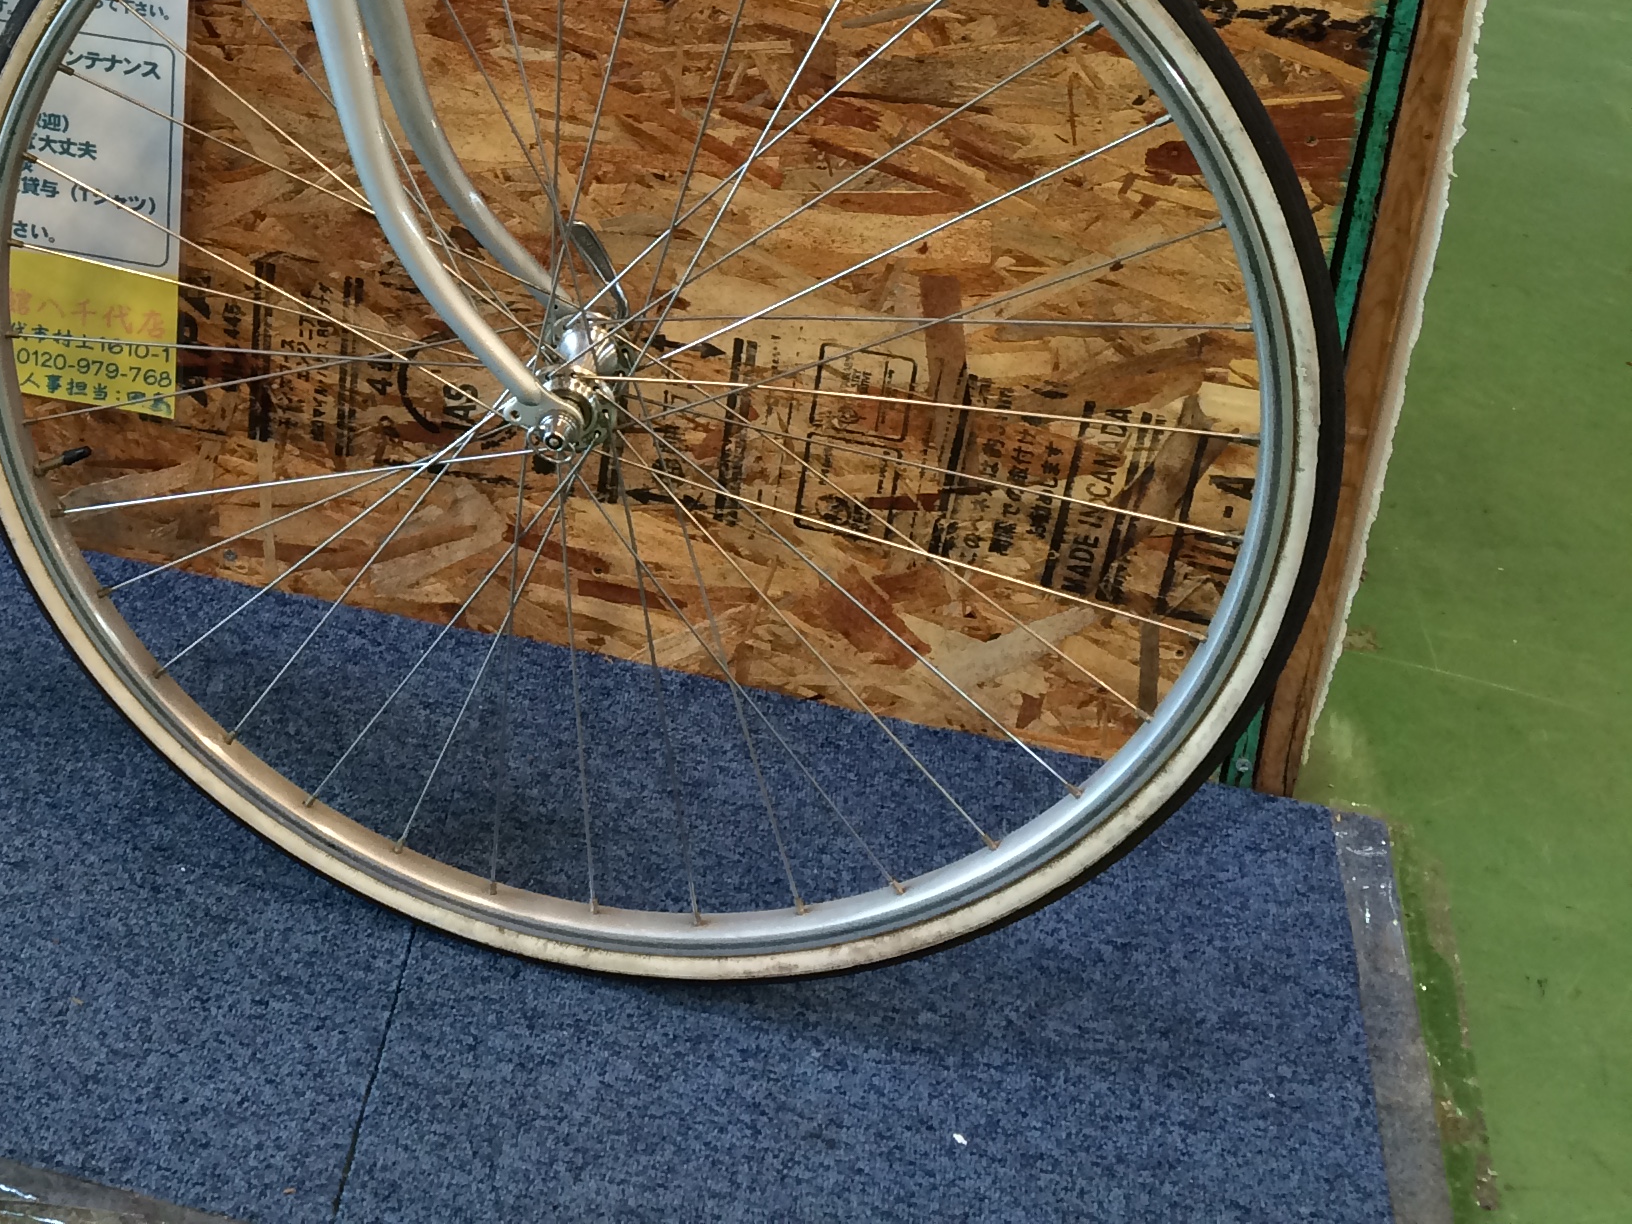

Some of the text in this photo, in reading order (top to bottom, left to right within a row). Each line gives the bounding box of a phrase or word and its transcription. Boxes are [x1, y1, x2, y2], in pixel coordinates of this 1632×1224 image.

[16, 347, 173, 389] 0120-979-768
[1061, 532, 1101, 596] MADE
[1086, 405, 1133, 501] CANADA
